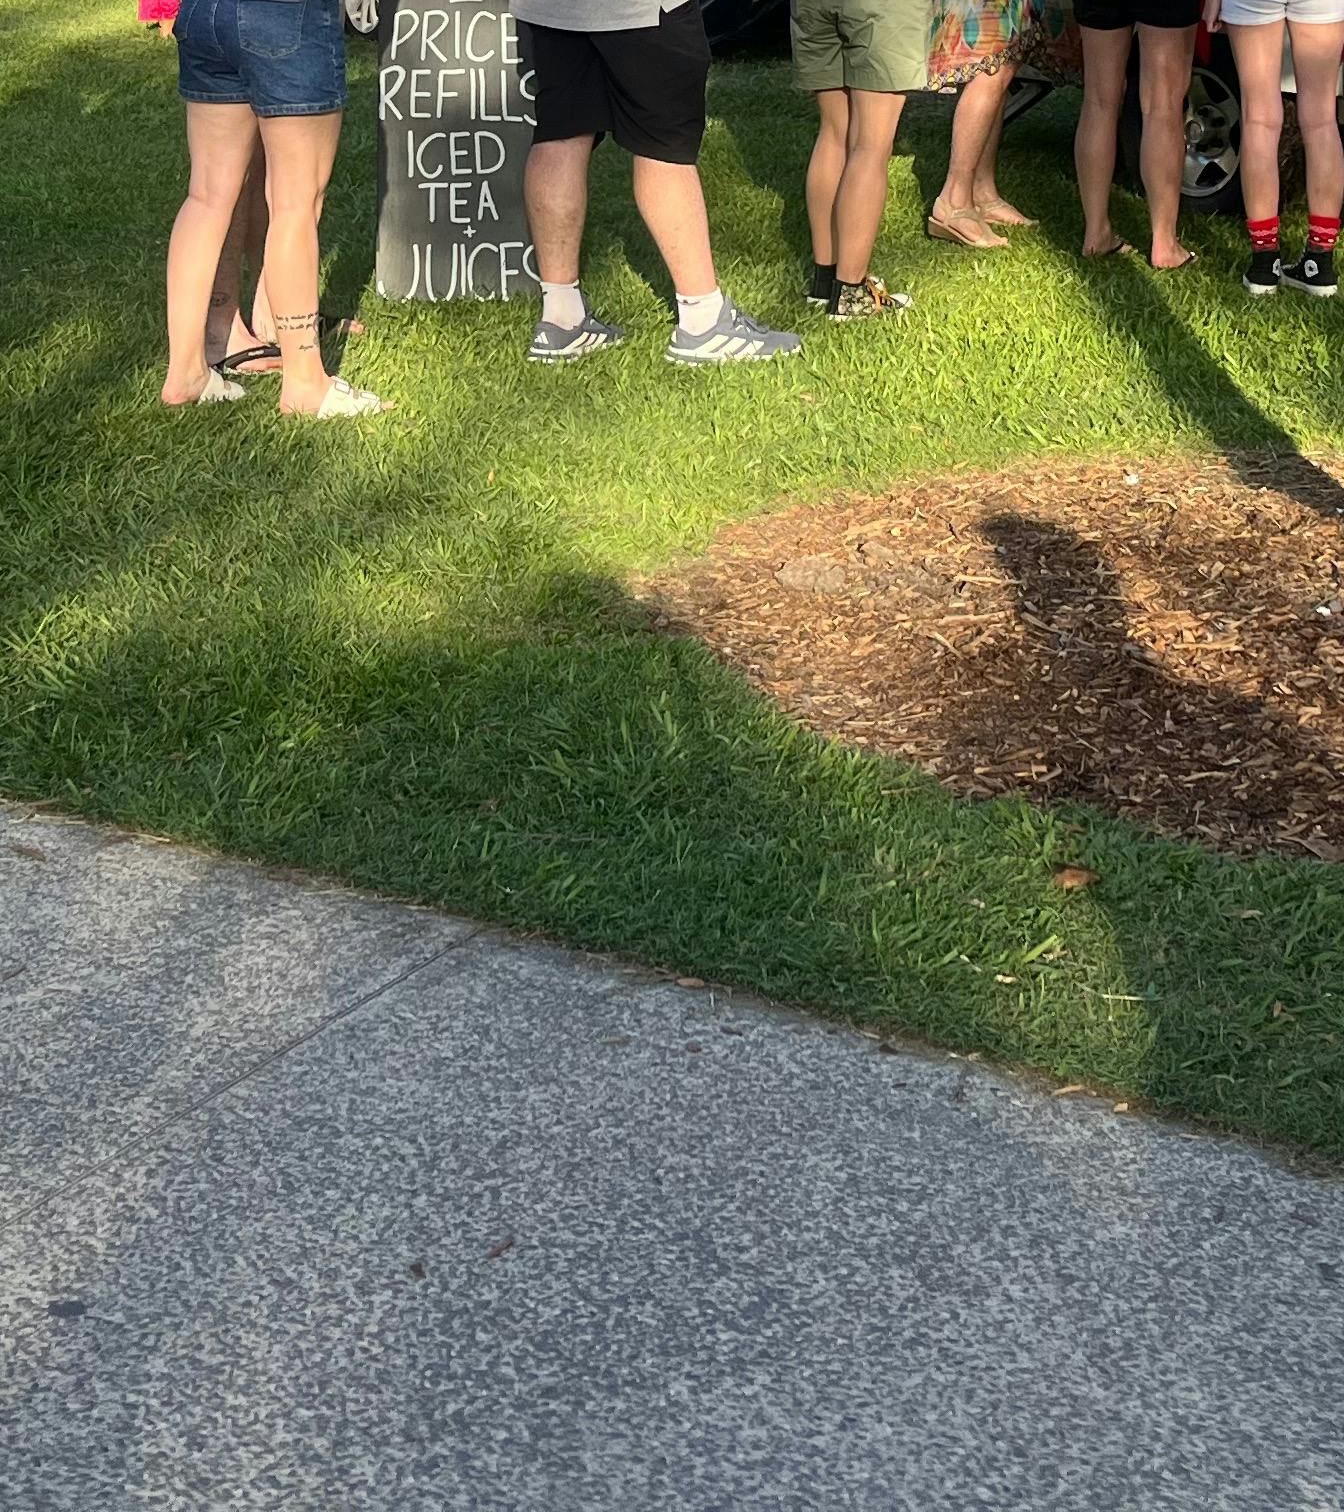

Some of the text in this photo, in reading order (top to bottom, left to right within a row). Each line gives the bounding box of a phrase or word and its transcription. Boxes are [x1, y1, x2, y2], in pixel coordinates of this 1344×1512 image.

[390, 9, 524, 64] PRICE
[407, 130, 506, 179] ICED
[418, 180, 499, 223] TEA
